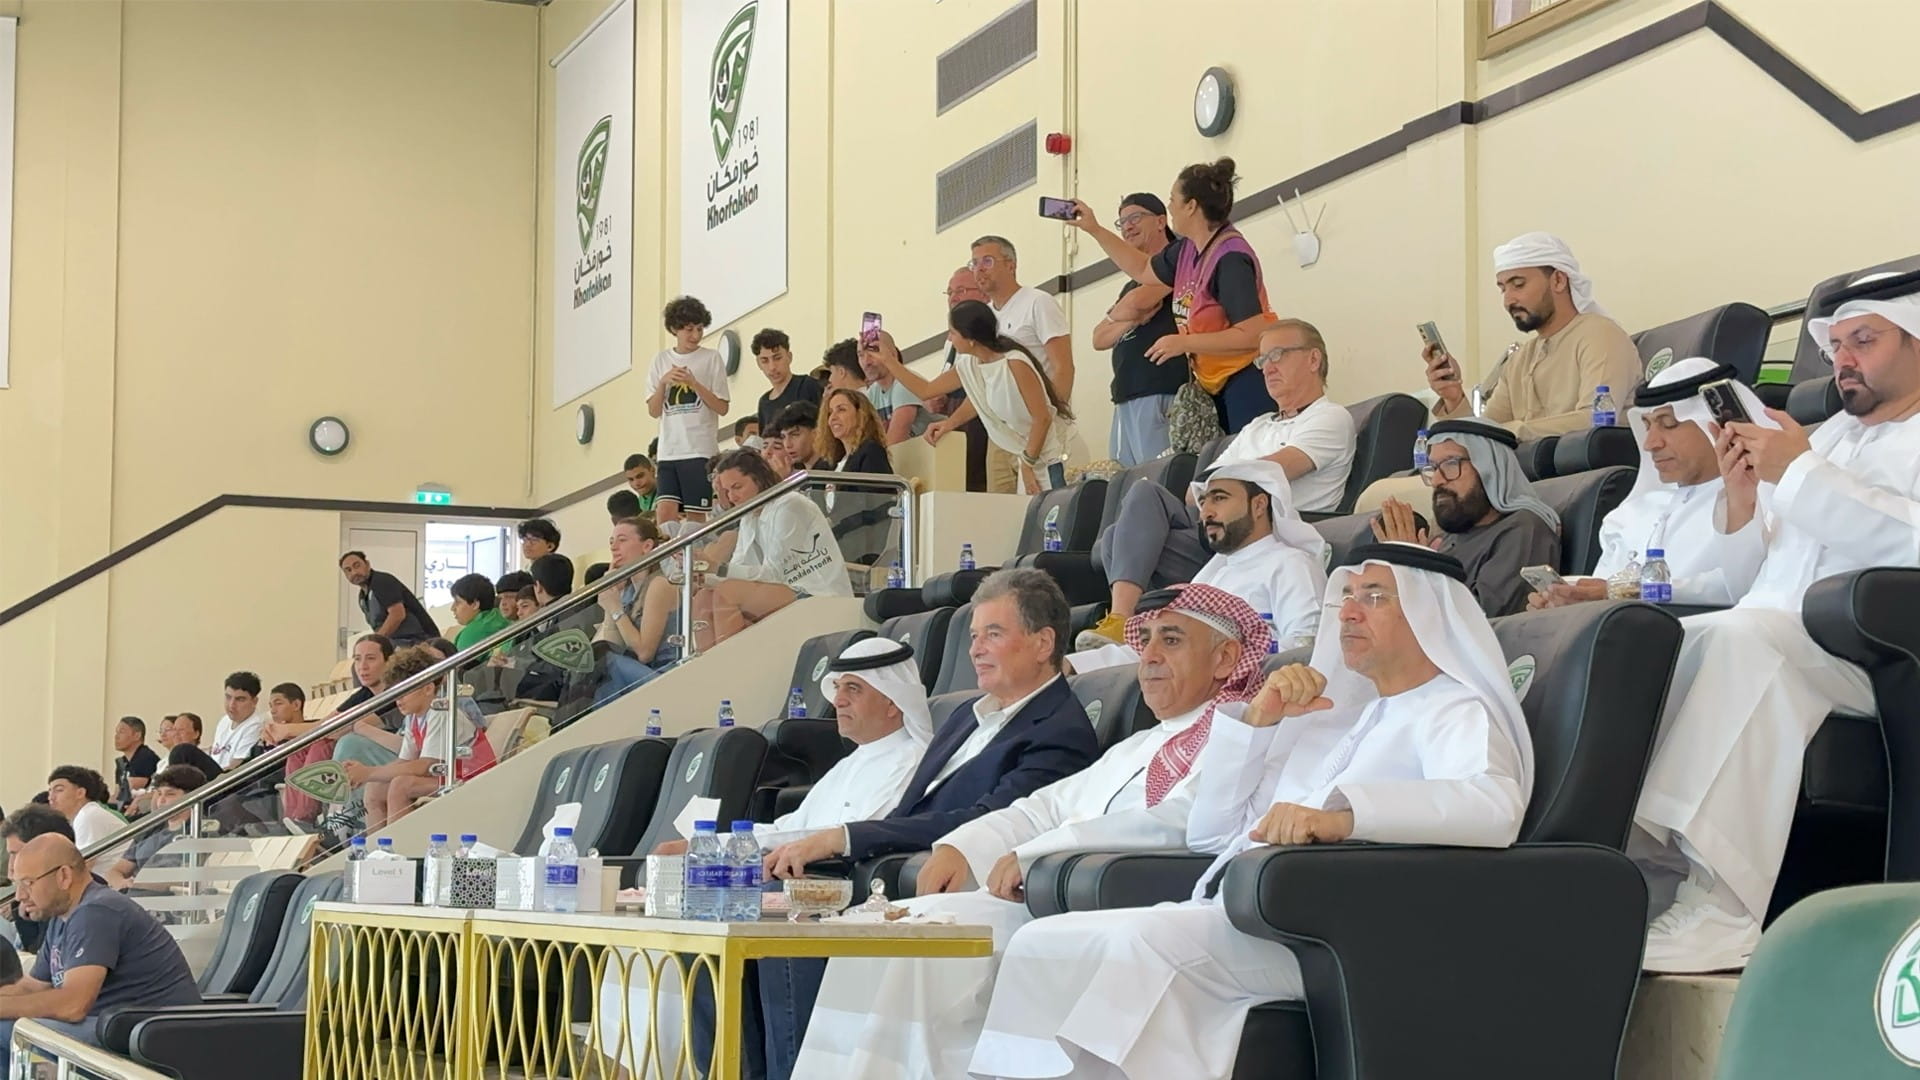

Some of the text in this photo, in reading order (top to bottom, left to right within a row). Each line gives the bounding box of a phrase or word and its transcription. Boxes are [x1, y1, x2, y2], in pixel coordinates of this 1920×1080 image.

[737, 116, 759, 148] 1981
[707, 145, 759, 202] خورفكان
[596, 214, 612, 240] 1981
[706, 183, 759, 231] Khorfakkan
[574, 239, 612, 285] خورفكان
[573, 272, 612, 310] Khorfakkan
